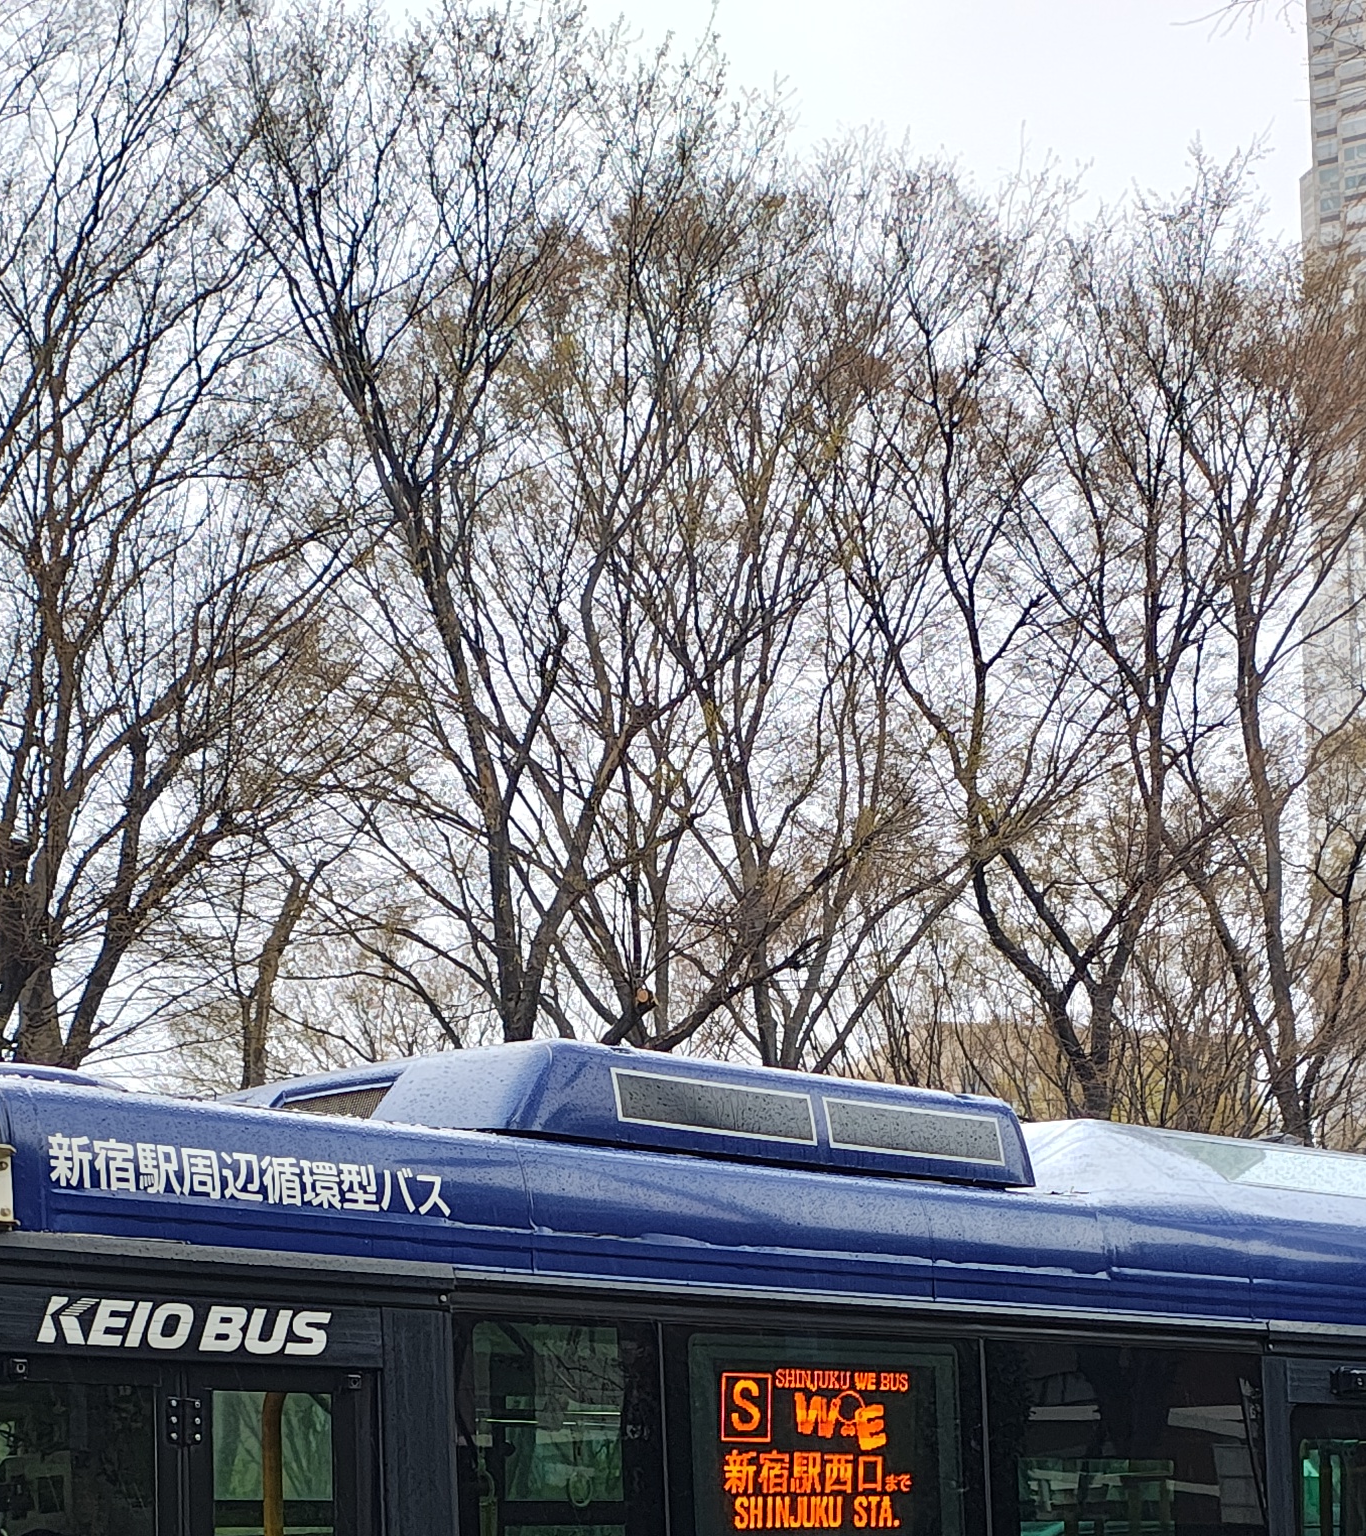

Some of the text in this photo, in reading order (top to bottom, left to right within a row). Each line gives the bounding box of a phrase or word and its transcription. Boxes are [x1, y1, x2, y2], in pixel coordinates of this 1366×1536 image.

[48, 1133, 452, 1218] 新宿駅周辺循環型バス
[37, 1296, 333, 1356] KEIO BUS
[775, 1368, 910, 1392] SHINJUKU WE BUS
[731, 1379, 761, 1432] S
[723, 1450, 913, 1494] 新宿駅西口まで
[734, 1496, 901, 1530] SHINJUKU STA.
